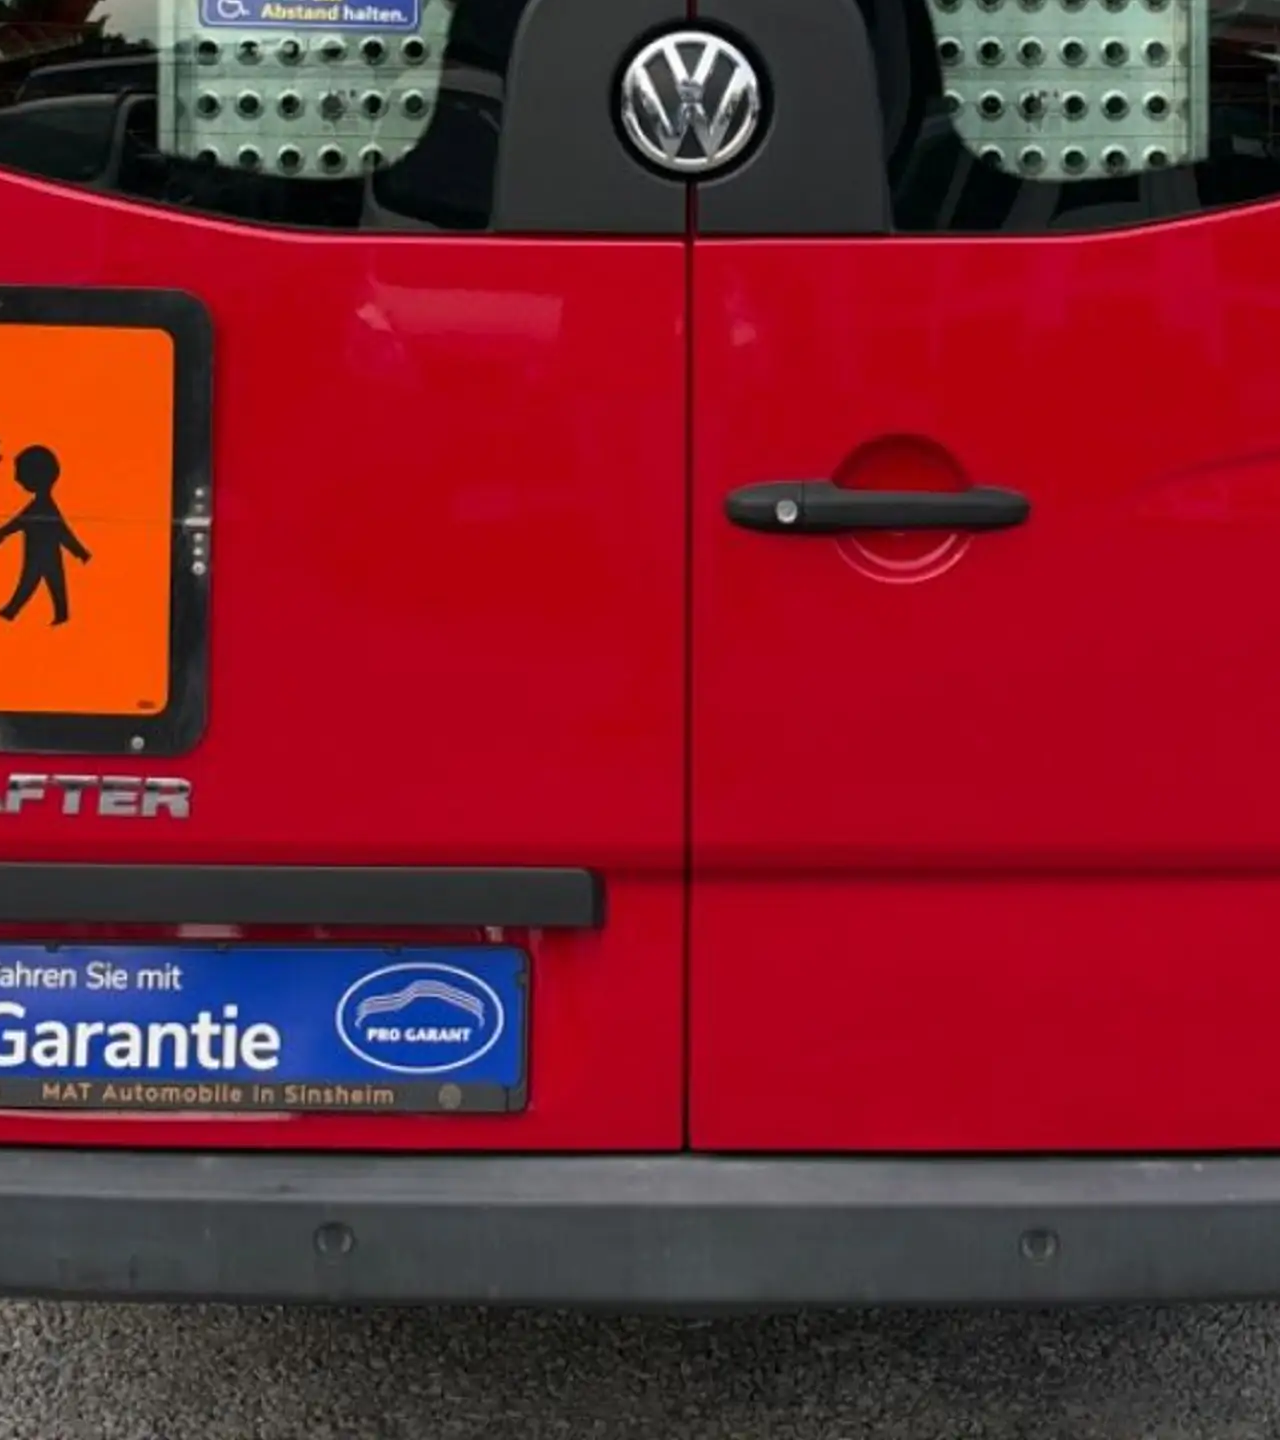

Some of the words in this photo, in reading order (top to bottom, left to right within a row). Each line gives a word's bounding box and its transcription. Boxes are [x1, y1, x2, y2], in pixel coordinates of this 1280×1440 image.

[261, 4, 338, 21] Abstand
[343, 5, 408, 23] halten.
[621, 31, 761, 173] VW
[85, 962, 128, 990] Sie
[136, 963, 183, 991] mit
[367, 1027, 401, 1043] PRO
[404, 1027, 472, 1043] GARANT
[41, 1082, 92, 1102] MAT
[101, 1083, 242, 1104] Automobile
[284, 1085, 395, 1105] Sinsheim
